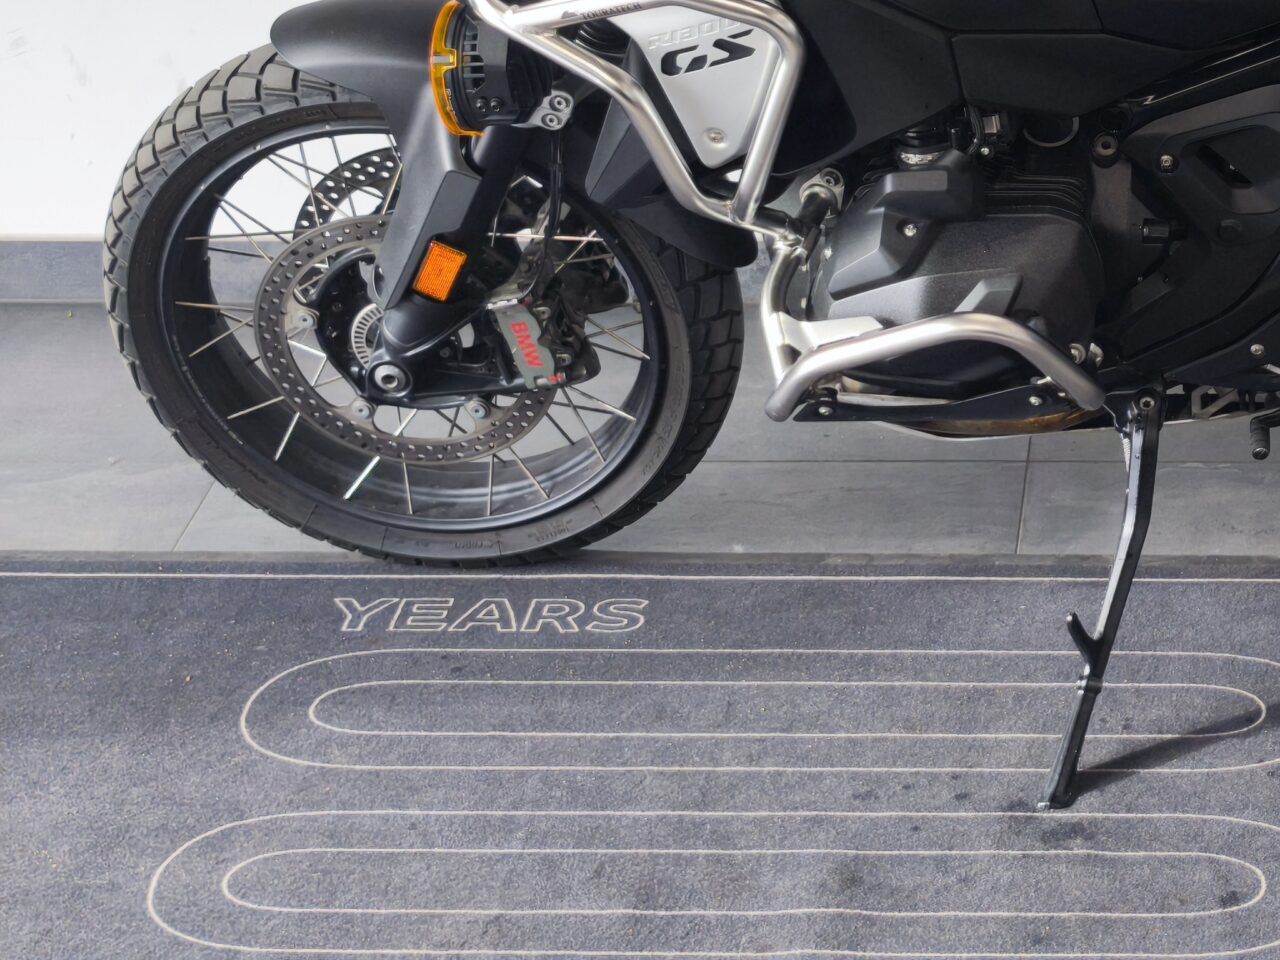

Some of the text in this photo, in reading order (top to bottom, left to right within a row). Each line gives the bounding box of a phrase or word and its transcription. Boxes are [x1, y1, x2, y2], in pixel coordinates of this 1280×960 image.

[580, 1, 642, 20] TOURATECH
[660, 28, 757, 77] GS
[510, 322, 544, 368] BMW
[334, 597, 649, 633] YEARS
